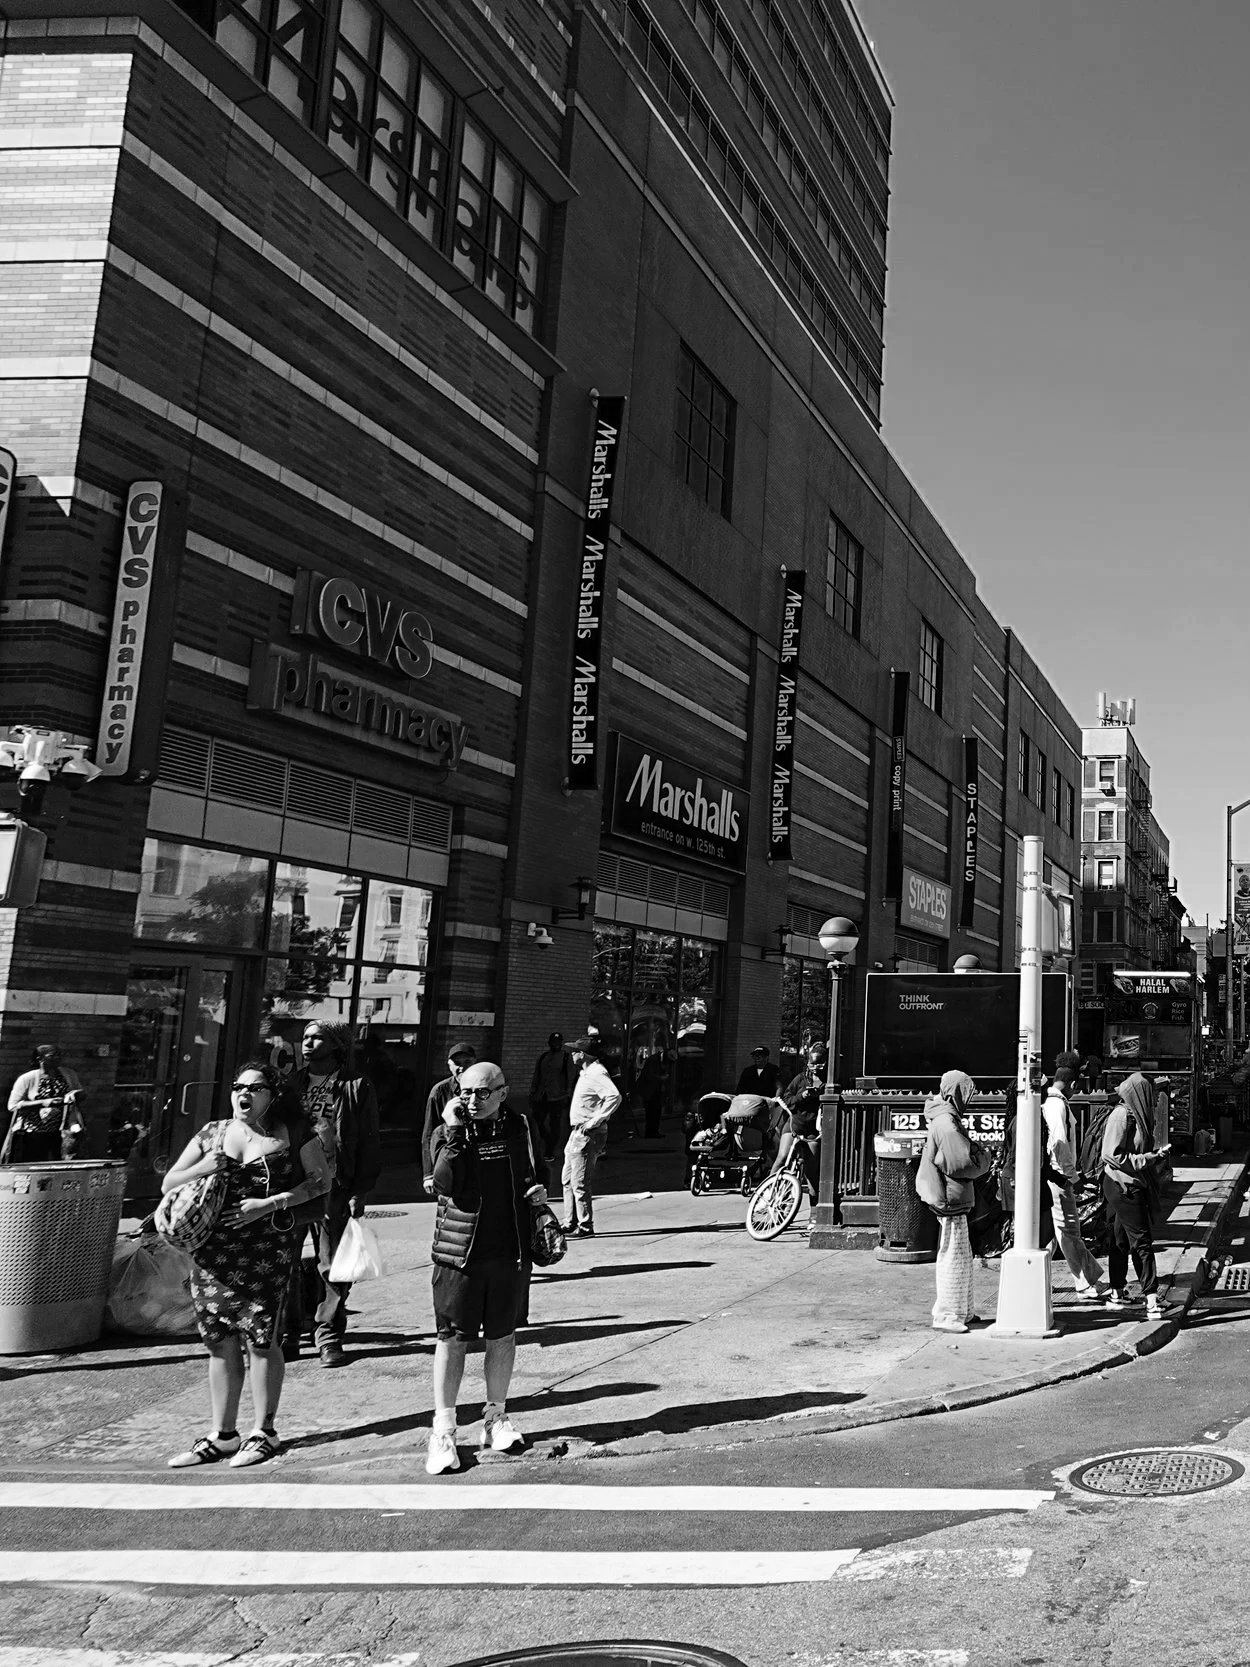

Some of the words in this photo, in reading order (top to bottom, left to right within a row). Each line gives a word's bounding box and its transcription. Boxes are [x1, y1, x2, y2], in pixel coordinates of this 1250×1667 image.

[588, 419, 618, 519] Marshalls
[122, 492, 159, 589] CVS
[577, 534, 605, 639] Marshalls
[781, 588, 802, 663] Marshalls
[319, 577, 434, 679] CVS
[104, 600, 140, 764] pharmacy
[272, 653, 470, 770] pharmacy
[571, 655, 597, 765] Marshalls
[775, 674, 796, 752] Marshalls
[625, 754, 740, 842] Marshalls
[772, 763, 791, 843] Marshalls
[892, 765, 902, 786] copy
[892, 789, 902, 811] print
[641, 821, 674, 841] entrance
[675, 833, 685, 846] on
[696, 837, 716, 856] 125th
[965, 783, 977, 882] STAPLES
[908, 875, 947, 920] STAPLES
[899, 994, 930, 1003] THINK
[1135, 986, 1170, 994] HARLEM
[1139, 978, 1166, 987] HALAL
[1171, 1001, 1187, 1009] Gyro
[891, 1115, 920, 1130] 125
